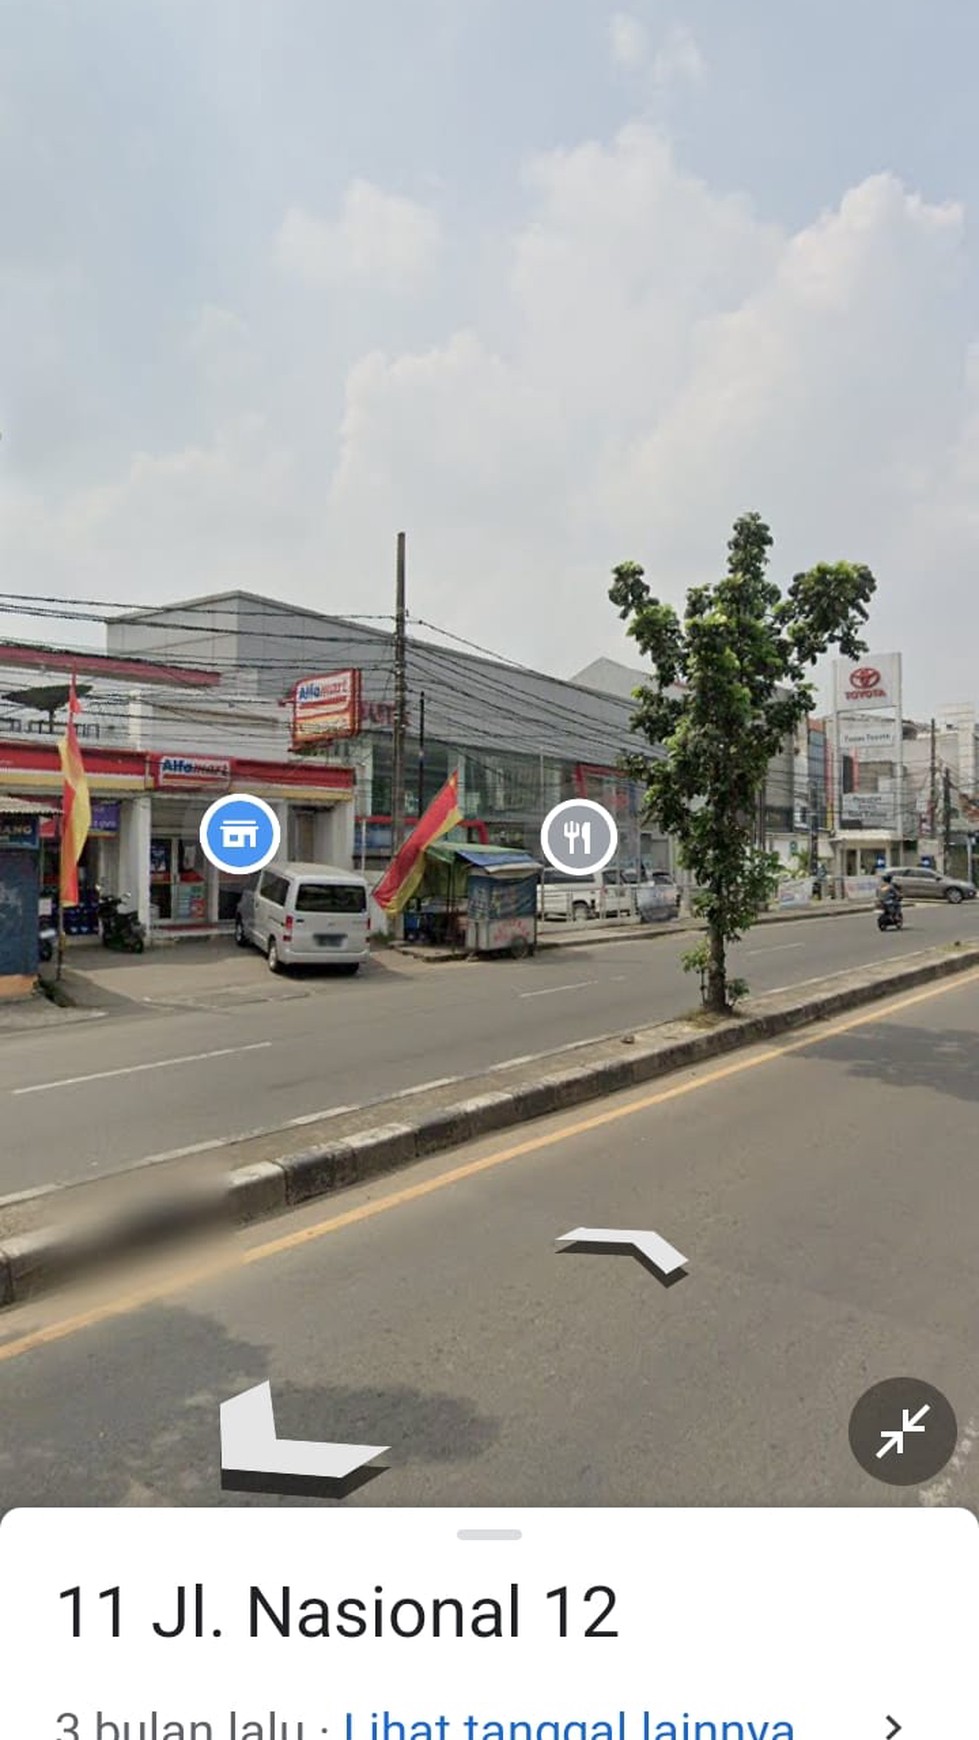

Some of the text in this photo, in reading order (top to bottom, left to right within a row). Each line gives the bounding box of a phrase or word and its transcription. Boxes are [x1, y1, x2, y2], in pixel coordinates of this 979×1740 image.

[299, 681, 348, 700] Alfamart
[845, 688, 887, 701] TOYOTA
[162, 758, 230, 776] Alfamart
